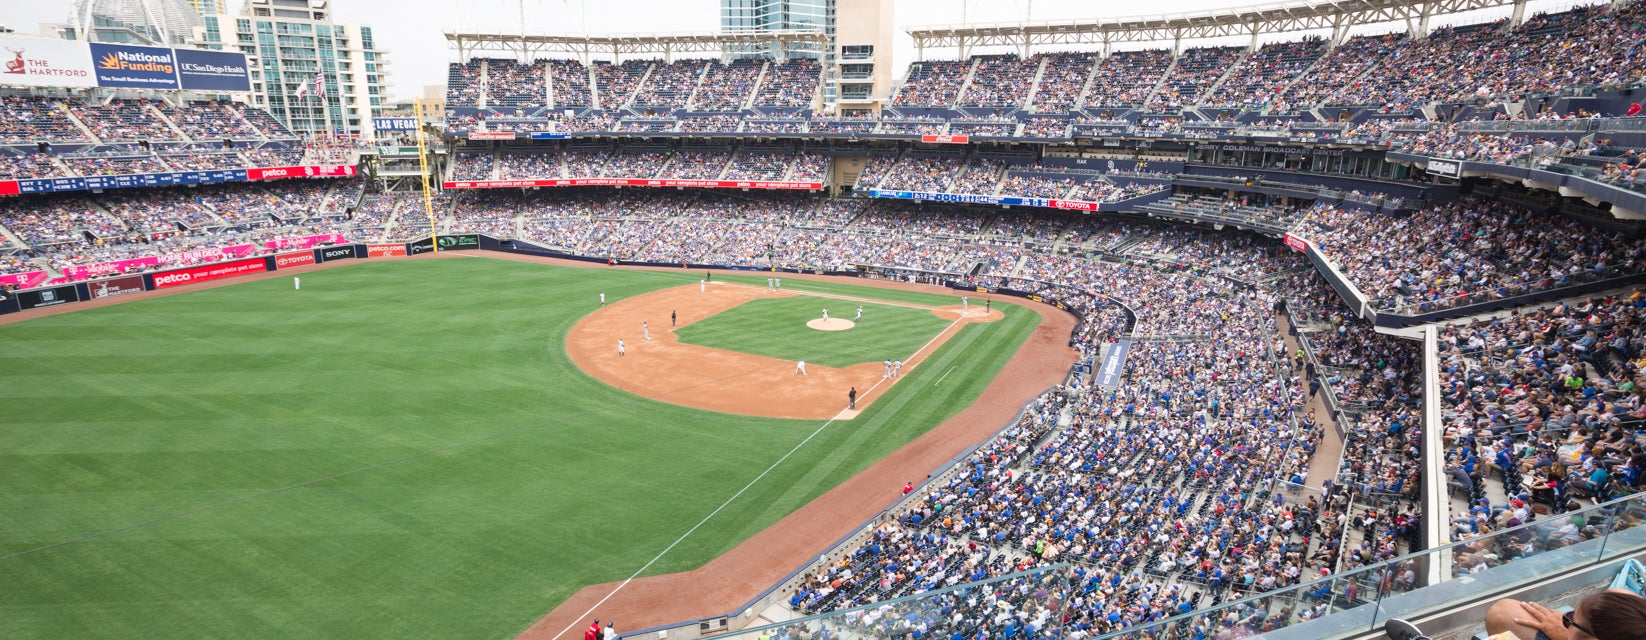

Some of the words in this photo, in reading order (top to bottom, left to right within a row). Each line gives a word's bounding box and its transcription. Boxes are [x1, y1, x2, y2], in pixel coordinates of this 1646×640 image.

[117, 51, 171, 63] National
[29, 68, 87, 76] HARTFORD
[120, 61, 173, 74] Funding
[206, 64, 224, 74] Diego
[376, 120, 391, 129] LAS
[392, 120, 418, 129] VEGAS
[262, 169, 287, 178] petco
[157, 252, 182, 264] HOME
[183, 251, 202, 260] RUN
[202, 248, 223, 257] DECK
[326, 249, 350, 257] SONY
[288, 255, 313, 263] TOYOTA
[155, 273, 191, 286] petco
[209, 267, 237, 276] complete
[108, 287, 140, 296] HARTFORD
